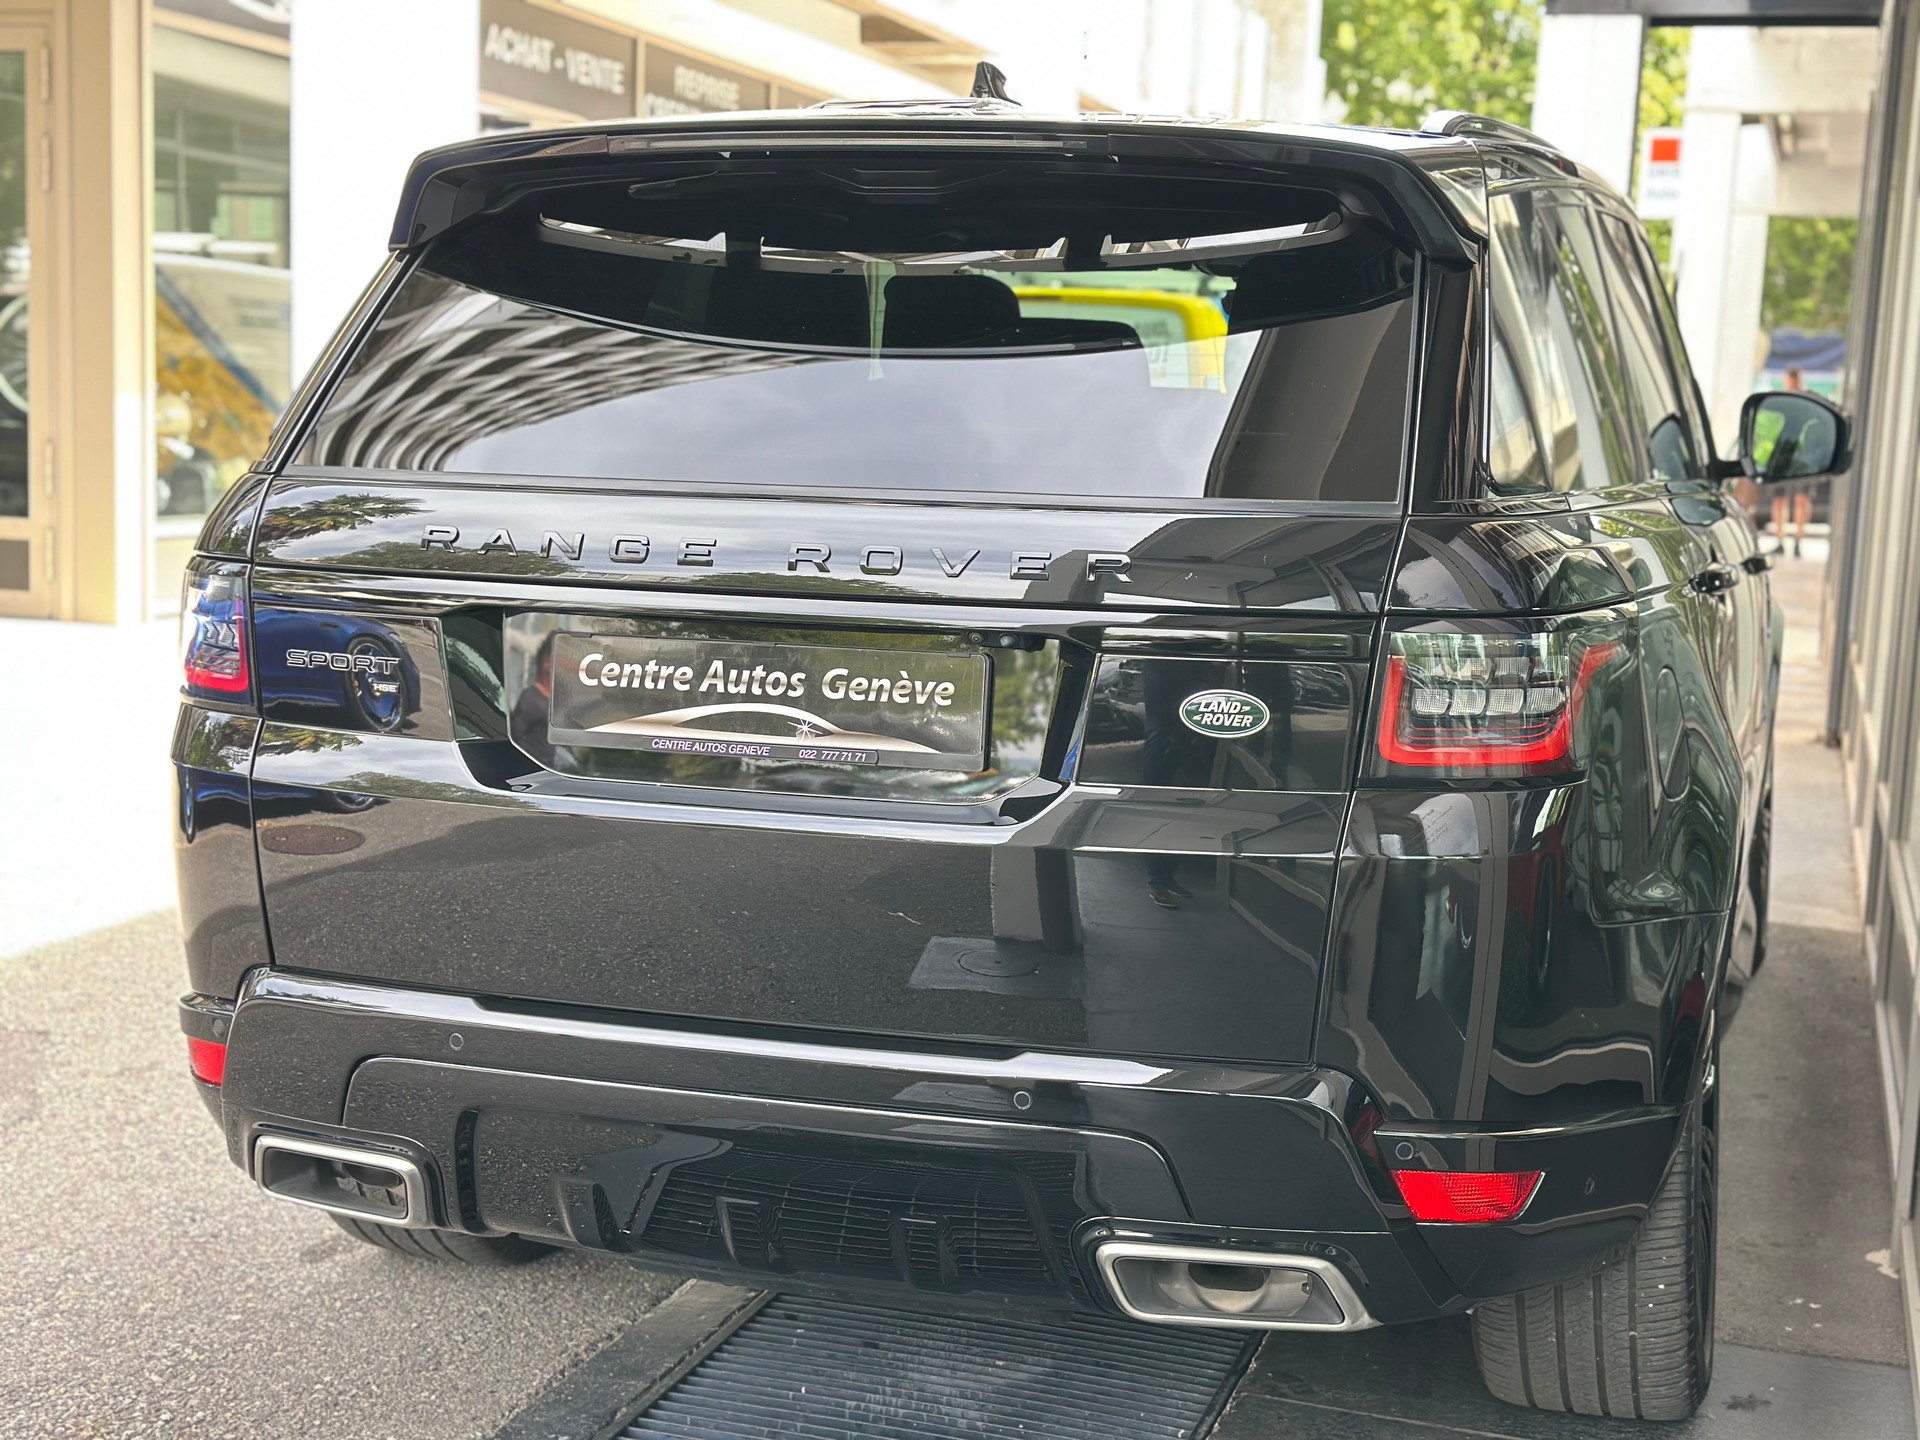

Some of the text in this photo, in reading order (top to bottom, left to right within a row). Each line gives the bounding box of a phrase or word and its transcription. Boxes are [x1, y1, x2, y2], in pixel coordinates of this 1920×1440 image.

[484, 22, 555, 75] ACHAT
[564, 46, 626, 96] VENTE
[419, 524, 1134, 584] RANGE ROVER
[285, 648, 401, 675] SPORT
[372, 682, 399, 693] HSE
[578, 653, 956, 707] Centre Autos Genève
[1198, 700, 1242, 714] LAND
[1200, 712, 1254, 728] ROVER
[651, 738, 867, 762] CENTRE AUTOS GENEVE 022 777 71 71
